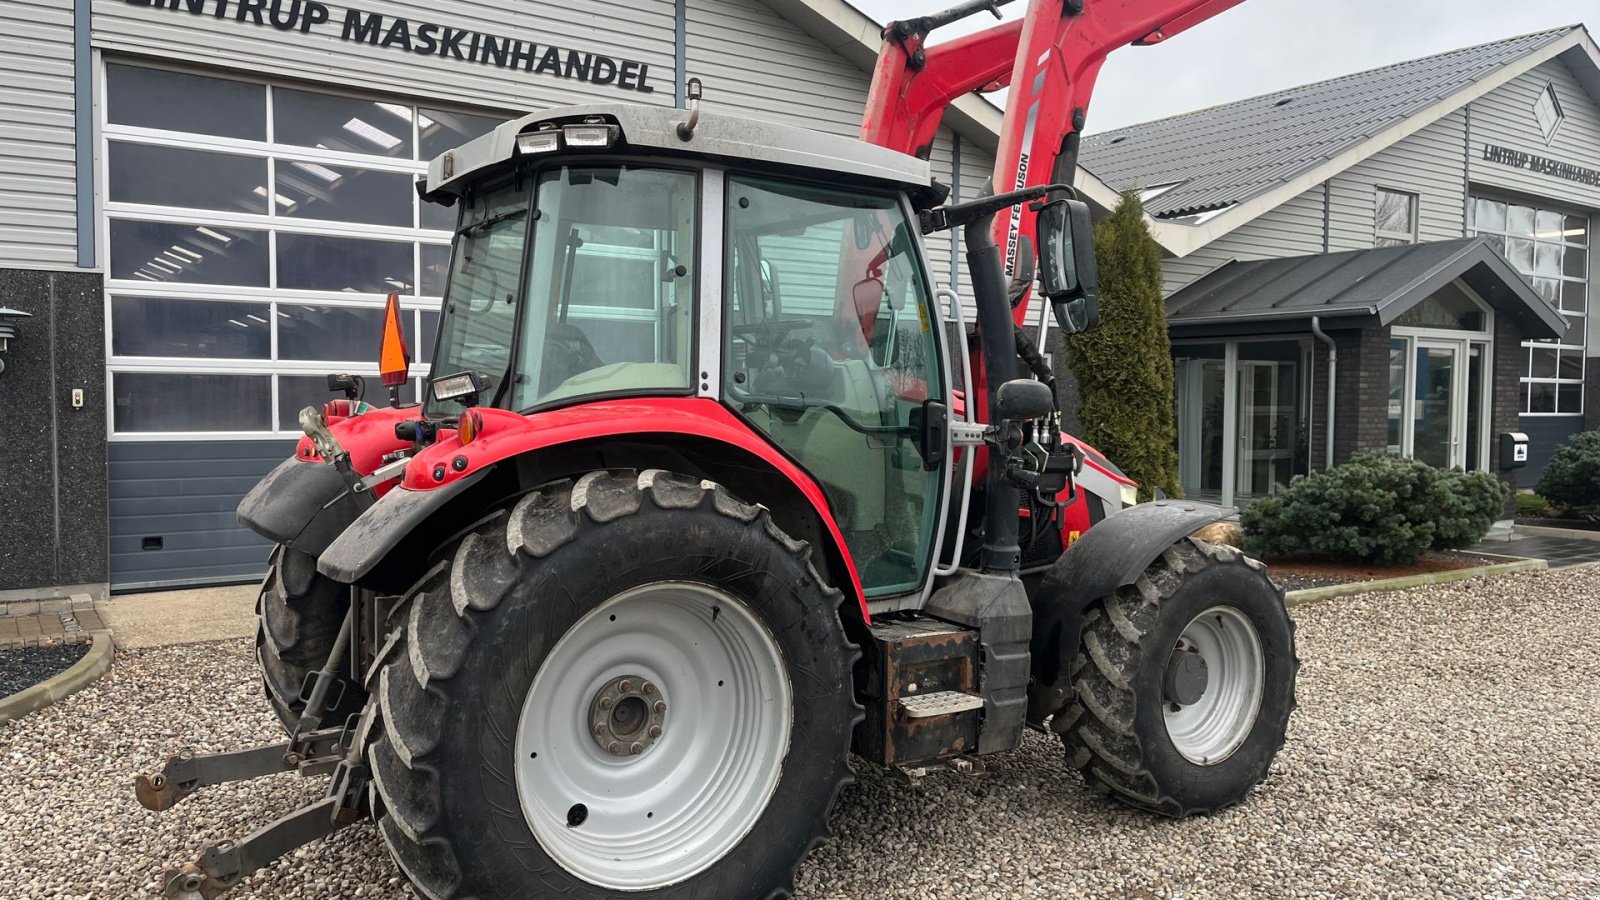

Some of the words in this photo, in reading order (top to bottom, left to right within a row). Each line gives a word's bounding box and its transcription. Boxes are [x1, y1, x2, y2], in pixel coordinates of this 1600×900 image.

[125, 0, 329, 34] TRUP
[341, 9, 654, 93] MASKINHANDEL
[1483, 143, 1528, 169] LINTRUP
[1005, 224, 1018, 277] MASSEY
[1012, 153, 1029, 222] FEUSON
